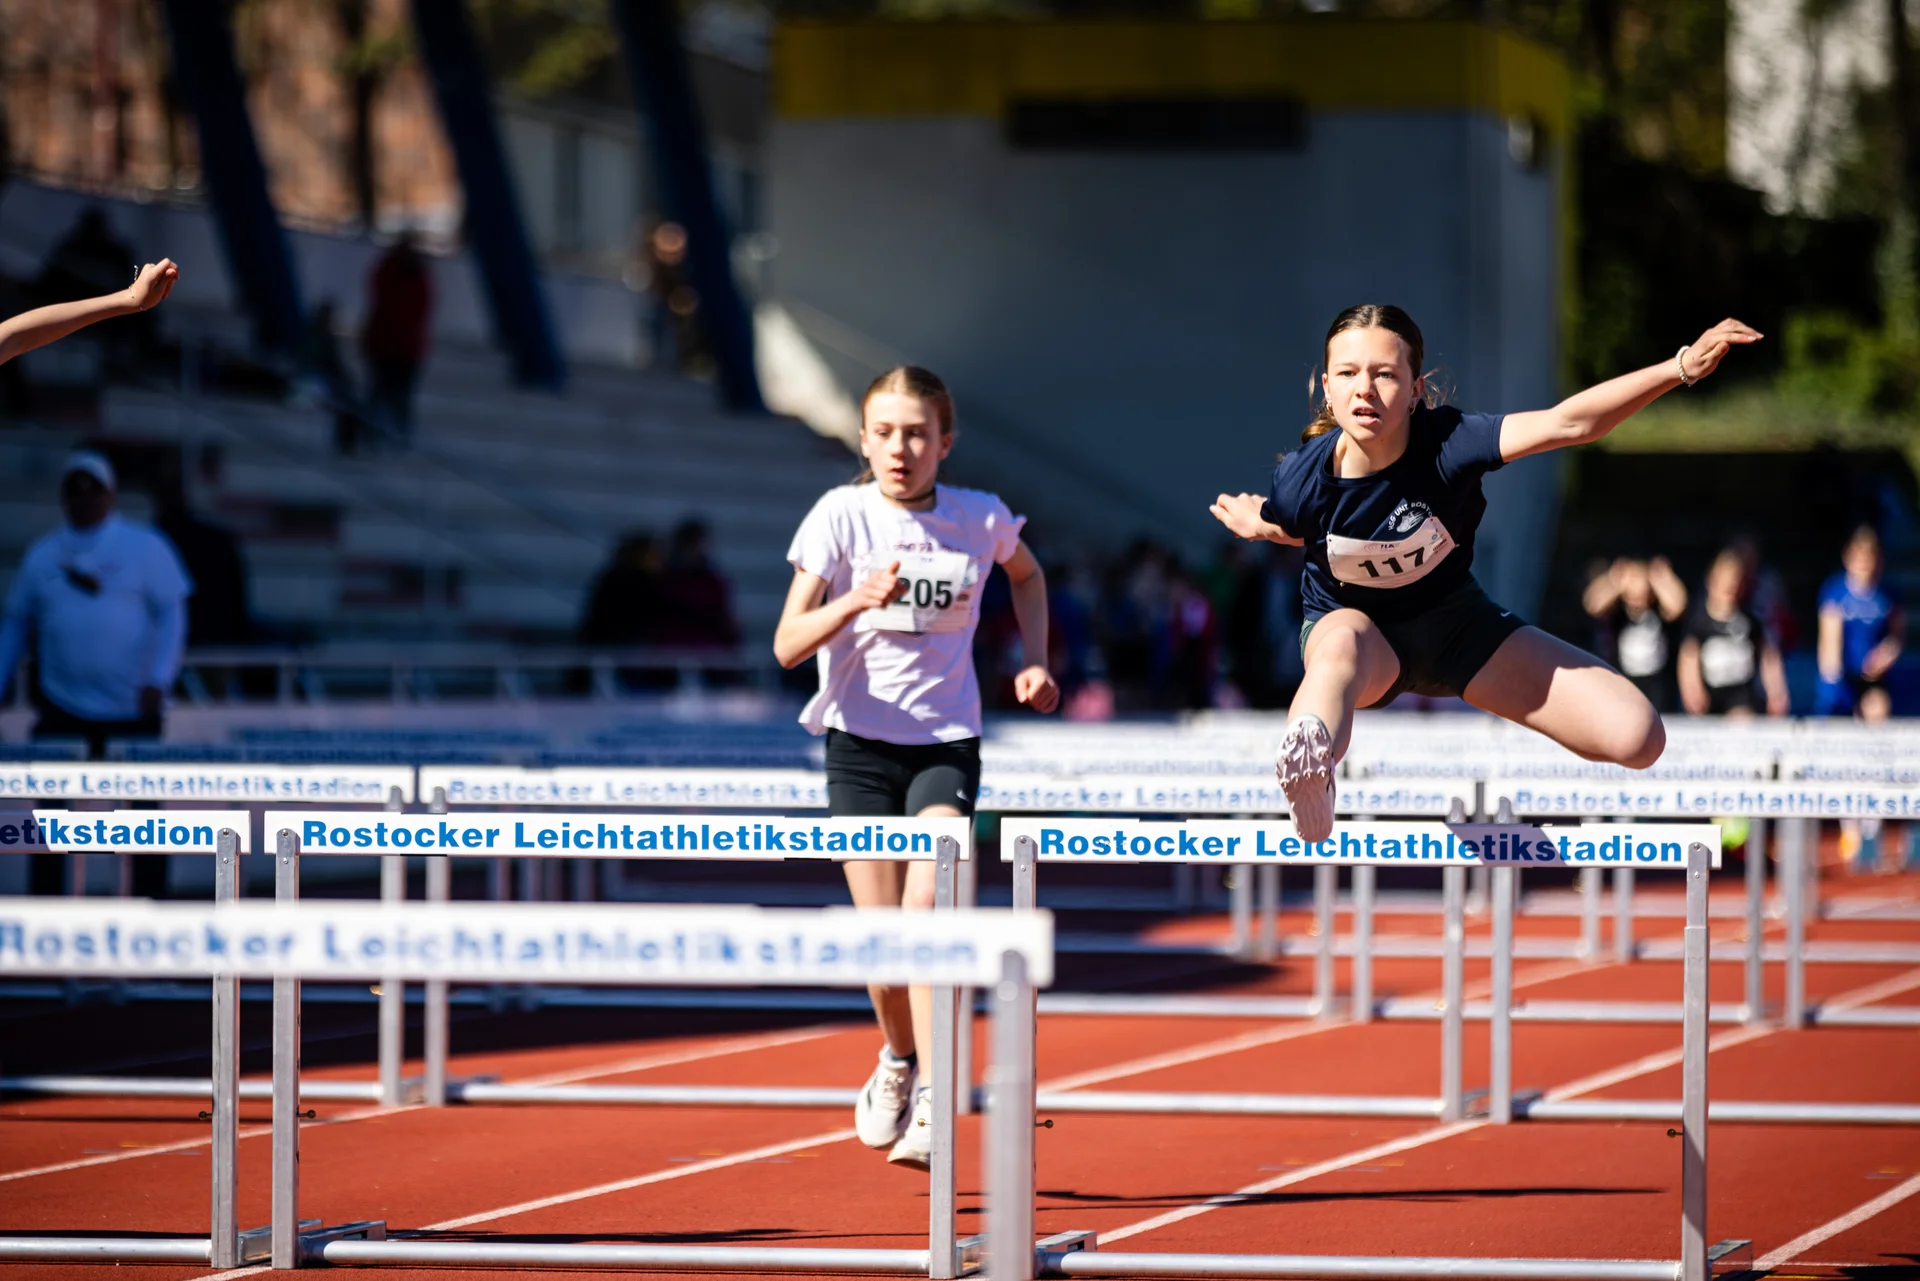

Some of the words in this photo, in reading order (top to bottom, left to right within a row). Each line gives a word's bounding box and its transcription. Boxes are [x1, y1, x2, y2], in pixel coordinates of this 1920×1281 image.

[1411, 501, 1433, 518] ROSTO
[1358, 547, 1425, 578] 117
[893, 577, 953, 610] 205
[81, 774, 382, 798] Leichtathletikstadion
[449, 780, 593, 801] Rostocker
[604, 781, 829, 802] Leichtathletiks
[977, 785, 1124, 807] Rostocker
[1136, 786, 1446, 810] Leichtathlstadion
[1515, 790, 1664, 812] Rostocker
[0, 818, 213, 846] etikstadion
[303, 820, 500, 848] Rostocker
[515, 822, 932, 853] Leichtathletikstadion
[1040, 828, 1241, 856] Rostocker
[1256, 830, 1682, 862] Leichtathletikstadion
[322, 921, 977, 966] Leichtathletikstadion
